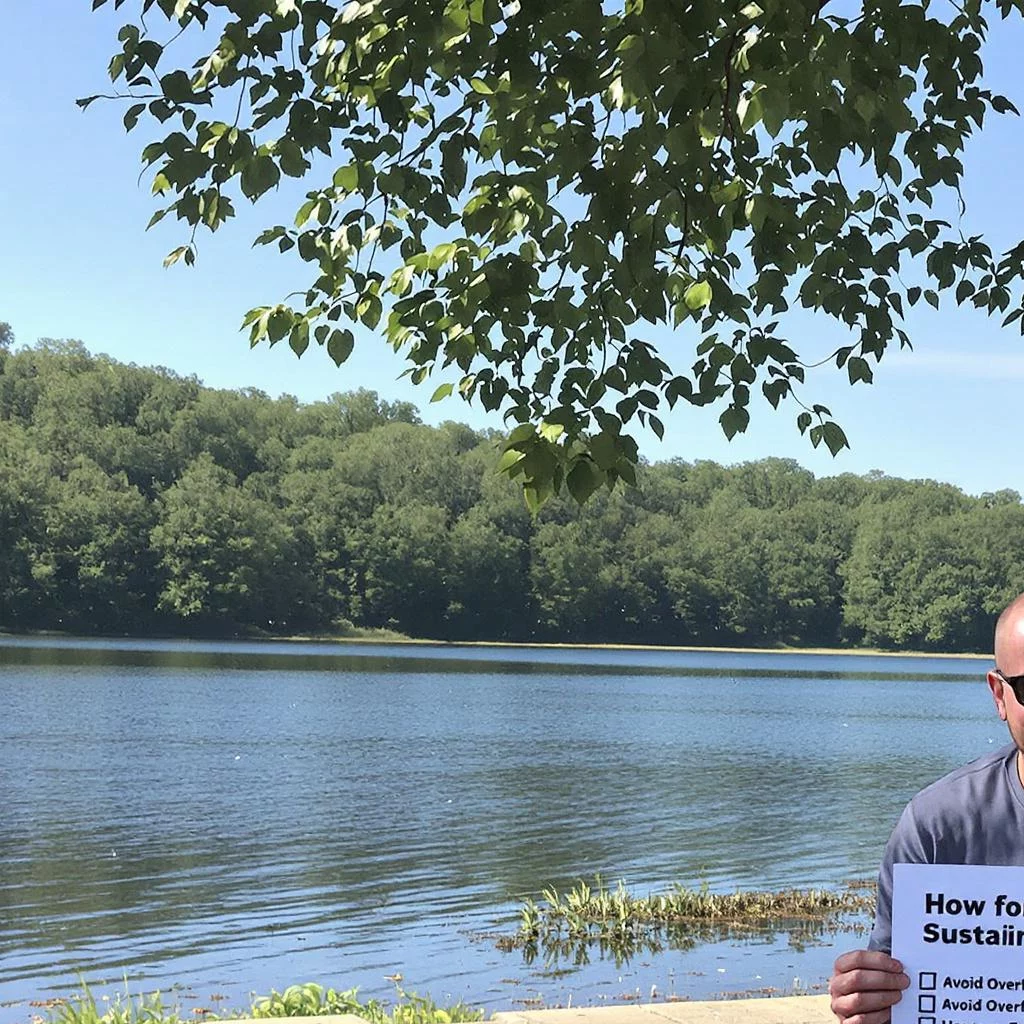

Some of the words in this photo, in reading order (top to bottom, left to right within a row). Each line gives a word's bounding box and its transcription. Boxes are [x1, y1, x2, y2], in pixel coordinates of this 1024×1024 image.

[925, 893, 986, 916] How
[943, 976, 984, 990] Avoid
[942, 998, 982, 1012] Avoid
